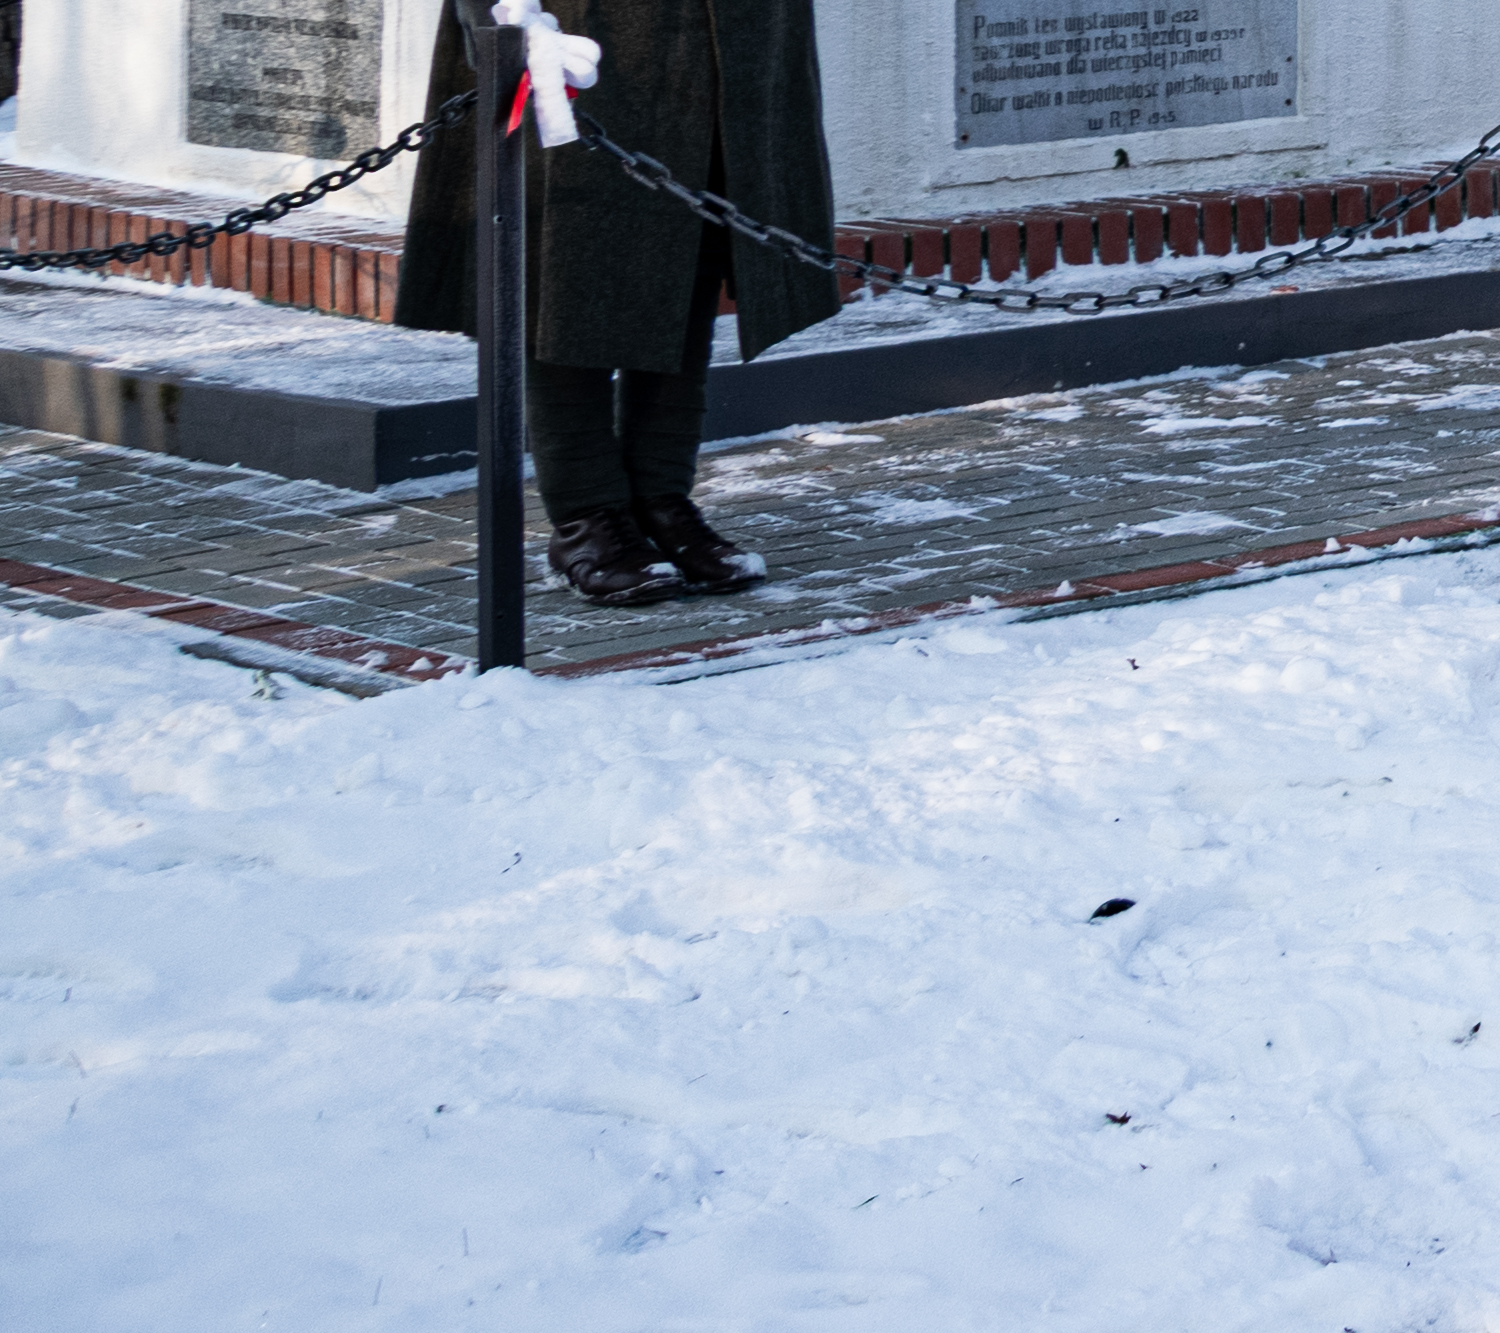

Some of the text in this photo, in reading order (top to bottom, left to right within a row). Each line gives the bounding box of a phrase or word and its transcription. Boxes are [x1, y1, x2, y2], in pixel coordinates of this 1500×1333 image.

[973, 15, 1029, 39] Pomnik
[1064, 10, 1148, 36] wystawiony
[1154, 10, 1166, 24] w
[1171, 9, 1199, 23] 1922
[1066, 53, 1087, 75] dla
[1091, 48, 1167, 74] wieczystej
[1012, 89, 1051, 111] walki
[1165, 73, 1229, 99] polskiego
[1232, 69, 1279, 90] narodu
